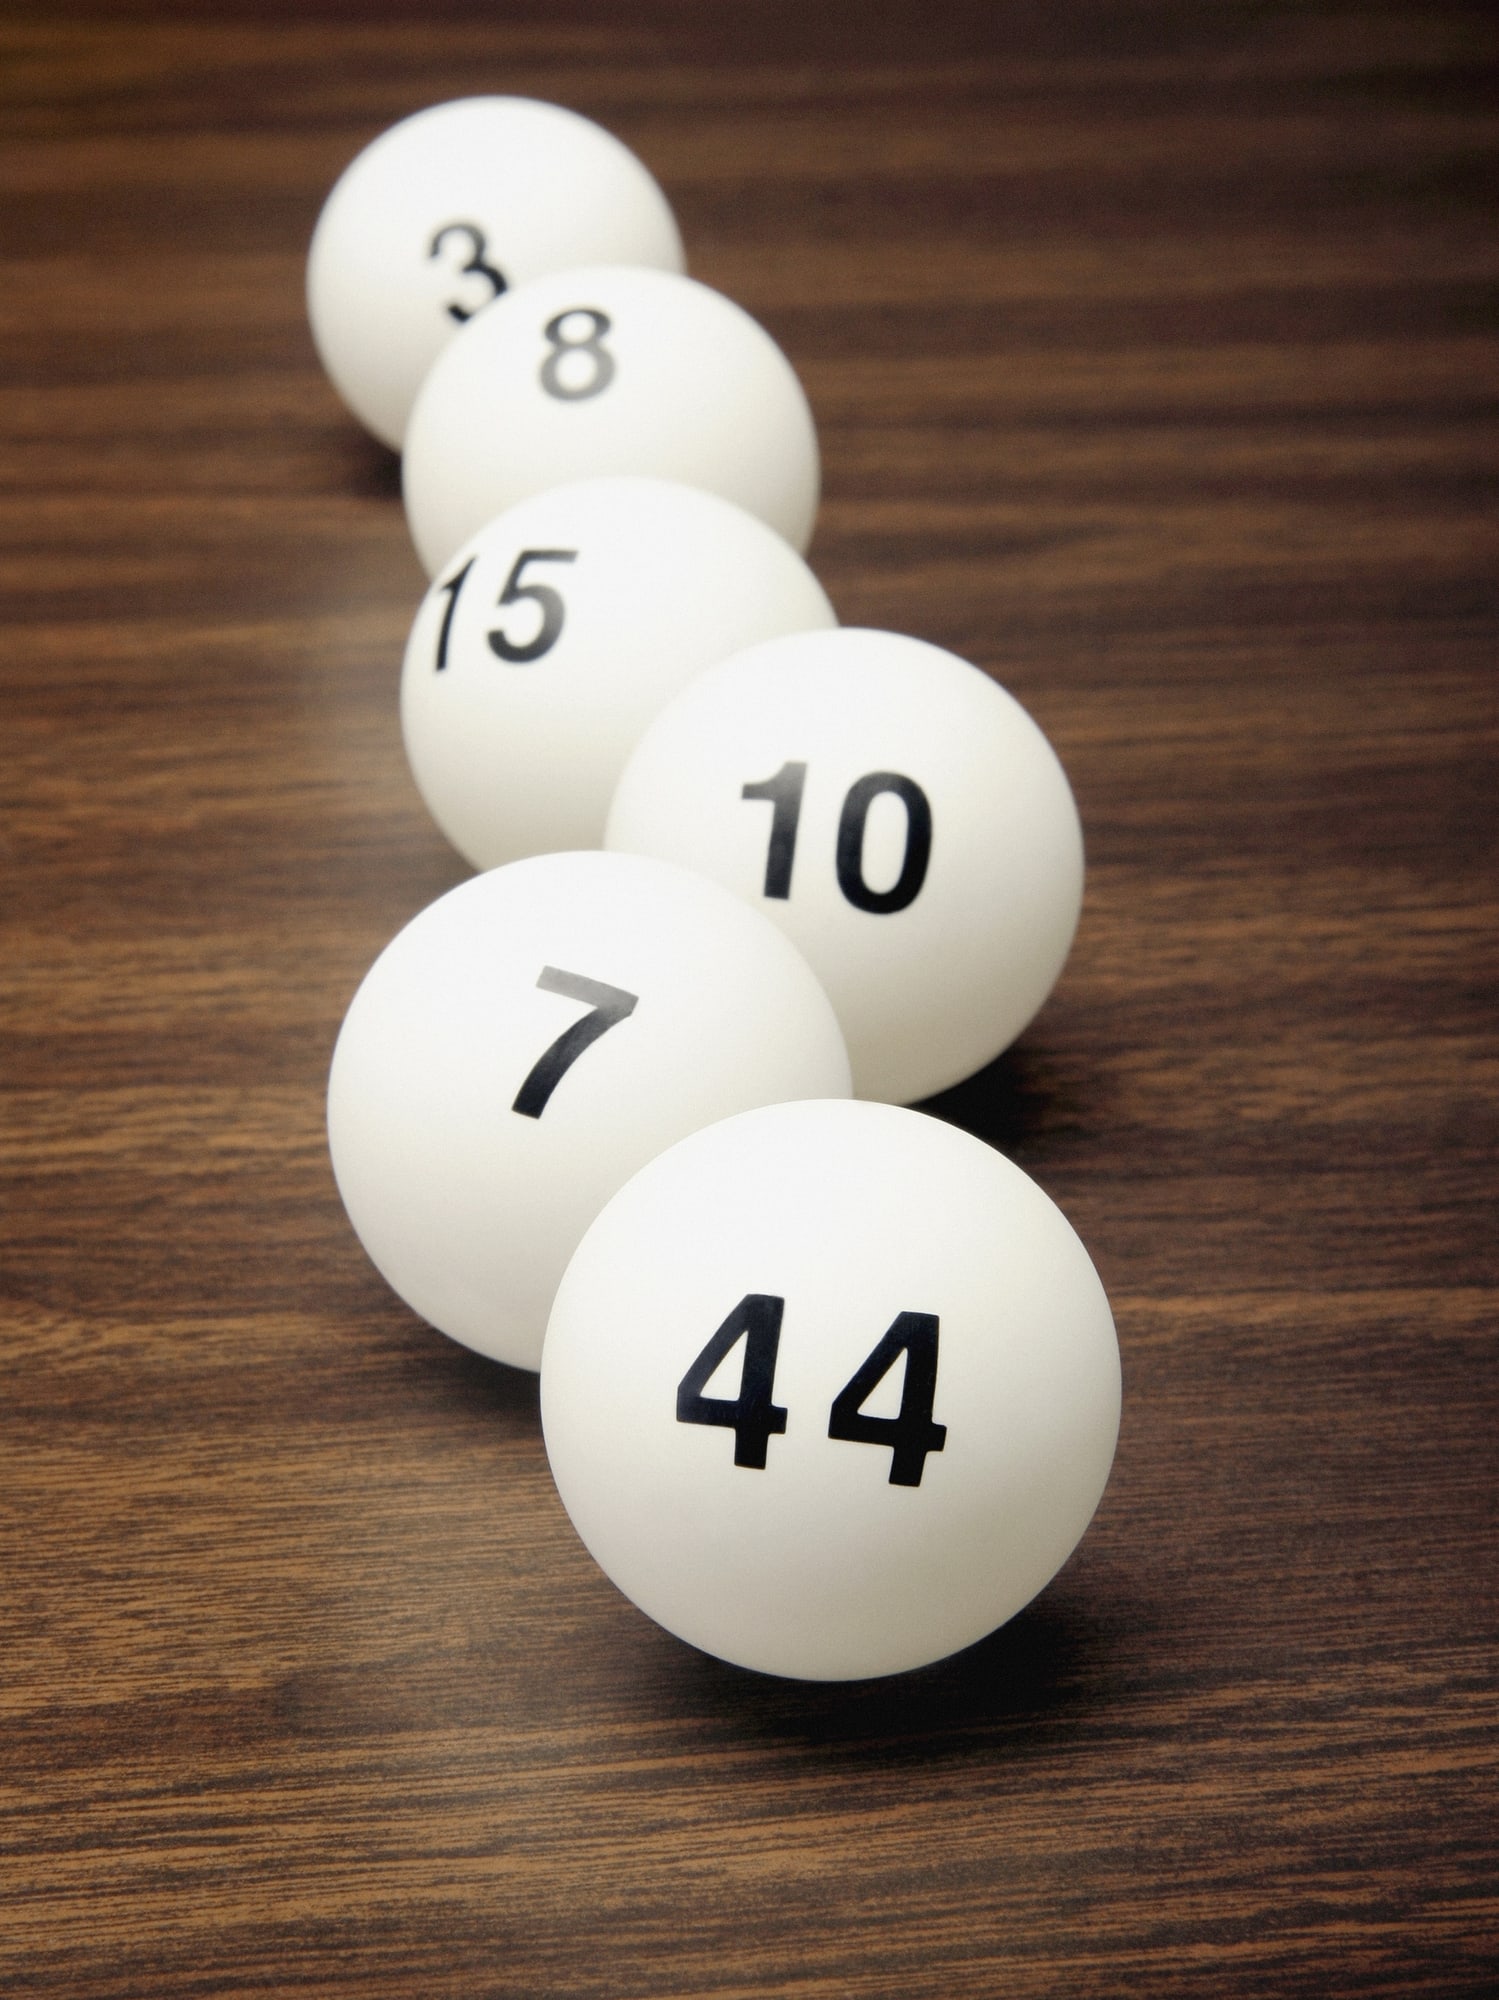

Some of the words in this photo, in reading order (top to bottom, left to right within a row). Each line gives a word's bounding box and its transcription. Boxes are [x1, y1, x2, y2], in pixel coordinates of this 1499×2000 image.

[429, 222, 509, 324] 3
[539, 307, 614, 402] 8
[434, 548, 578, 672] 15
[740, 762, 935, 917] 10
[511, 966, 638, 1120] 7
[676, 1294, 949, 1491] 44
